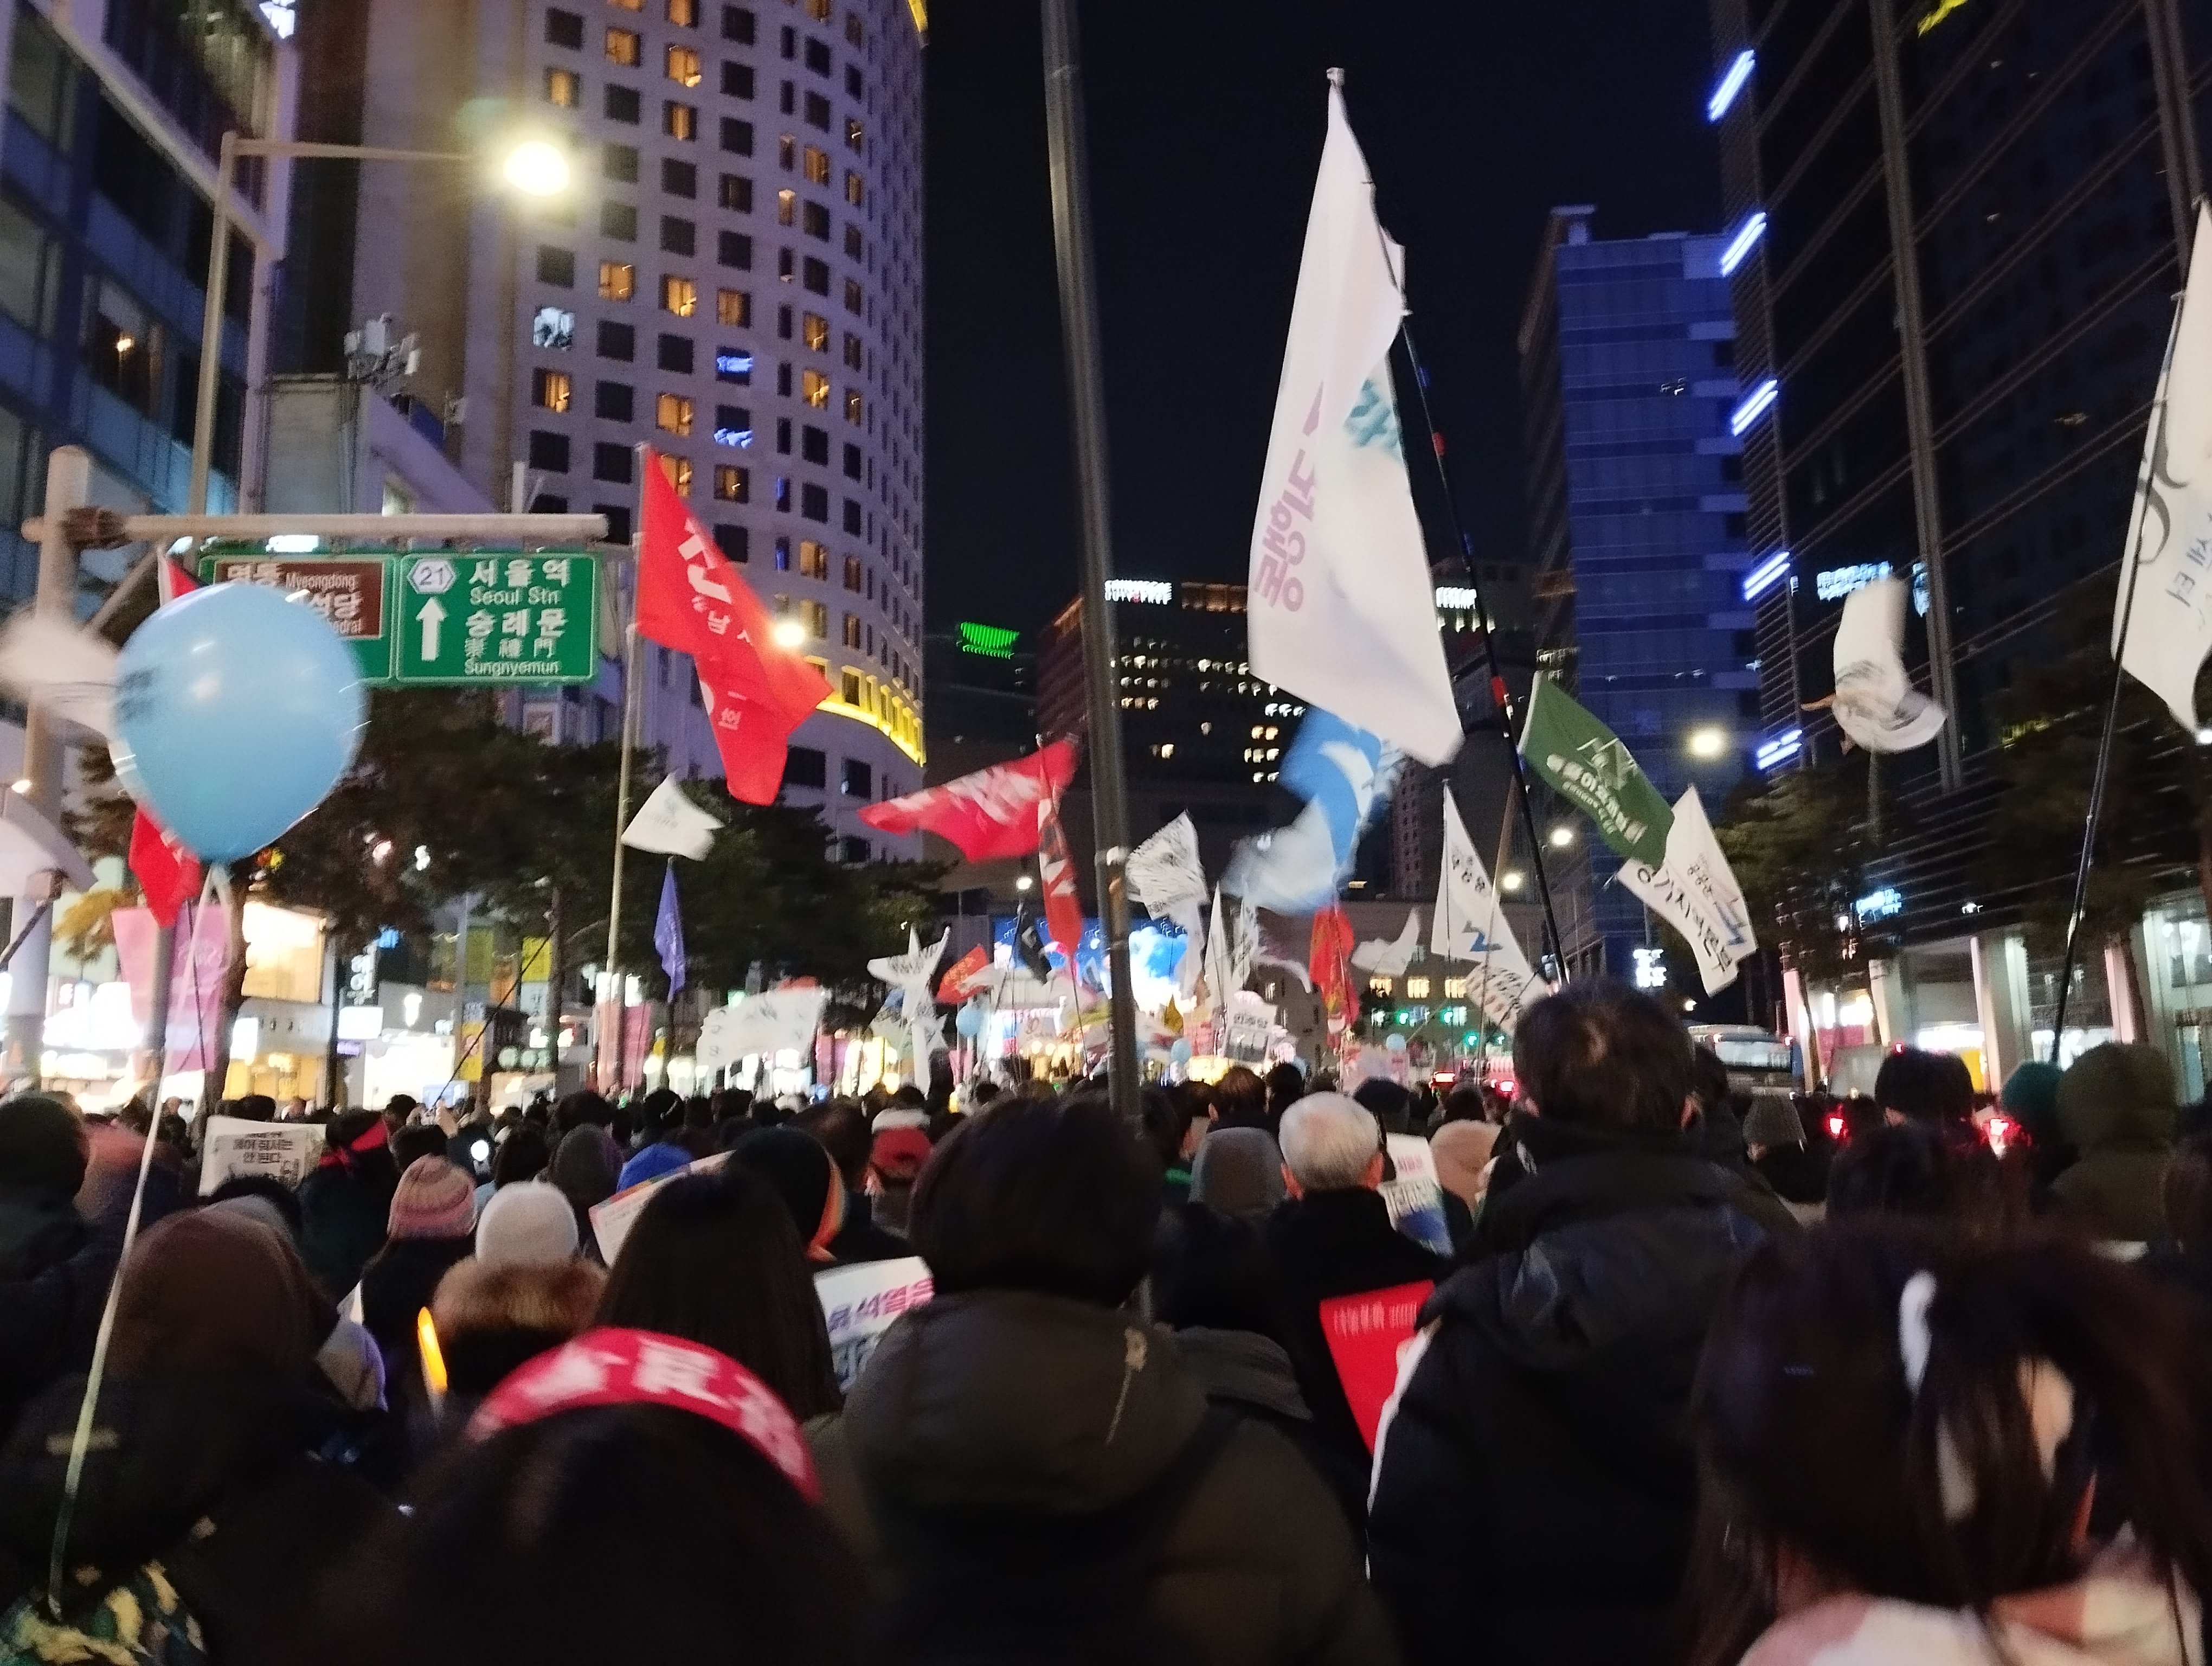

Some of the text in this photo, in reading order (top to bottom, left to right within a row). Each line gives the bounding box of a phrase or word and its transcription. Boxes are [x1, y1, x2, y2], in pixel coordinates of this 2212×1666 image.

[286, 572, 359, 592] Myeongdong
[419, 567, 445, 586] 21
[470, 559, 569, 587] 서울역
[307, 590, 363, 619] 성당
[470, 586, 561, 605] Seoul Stn
[465, 608, 568, 638] 숭례문
[465, 657, 562, 676] Sungnyemun
